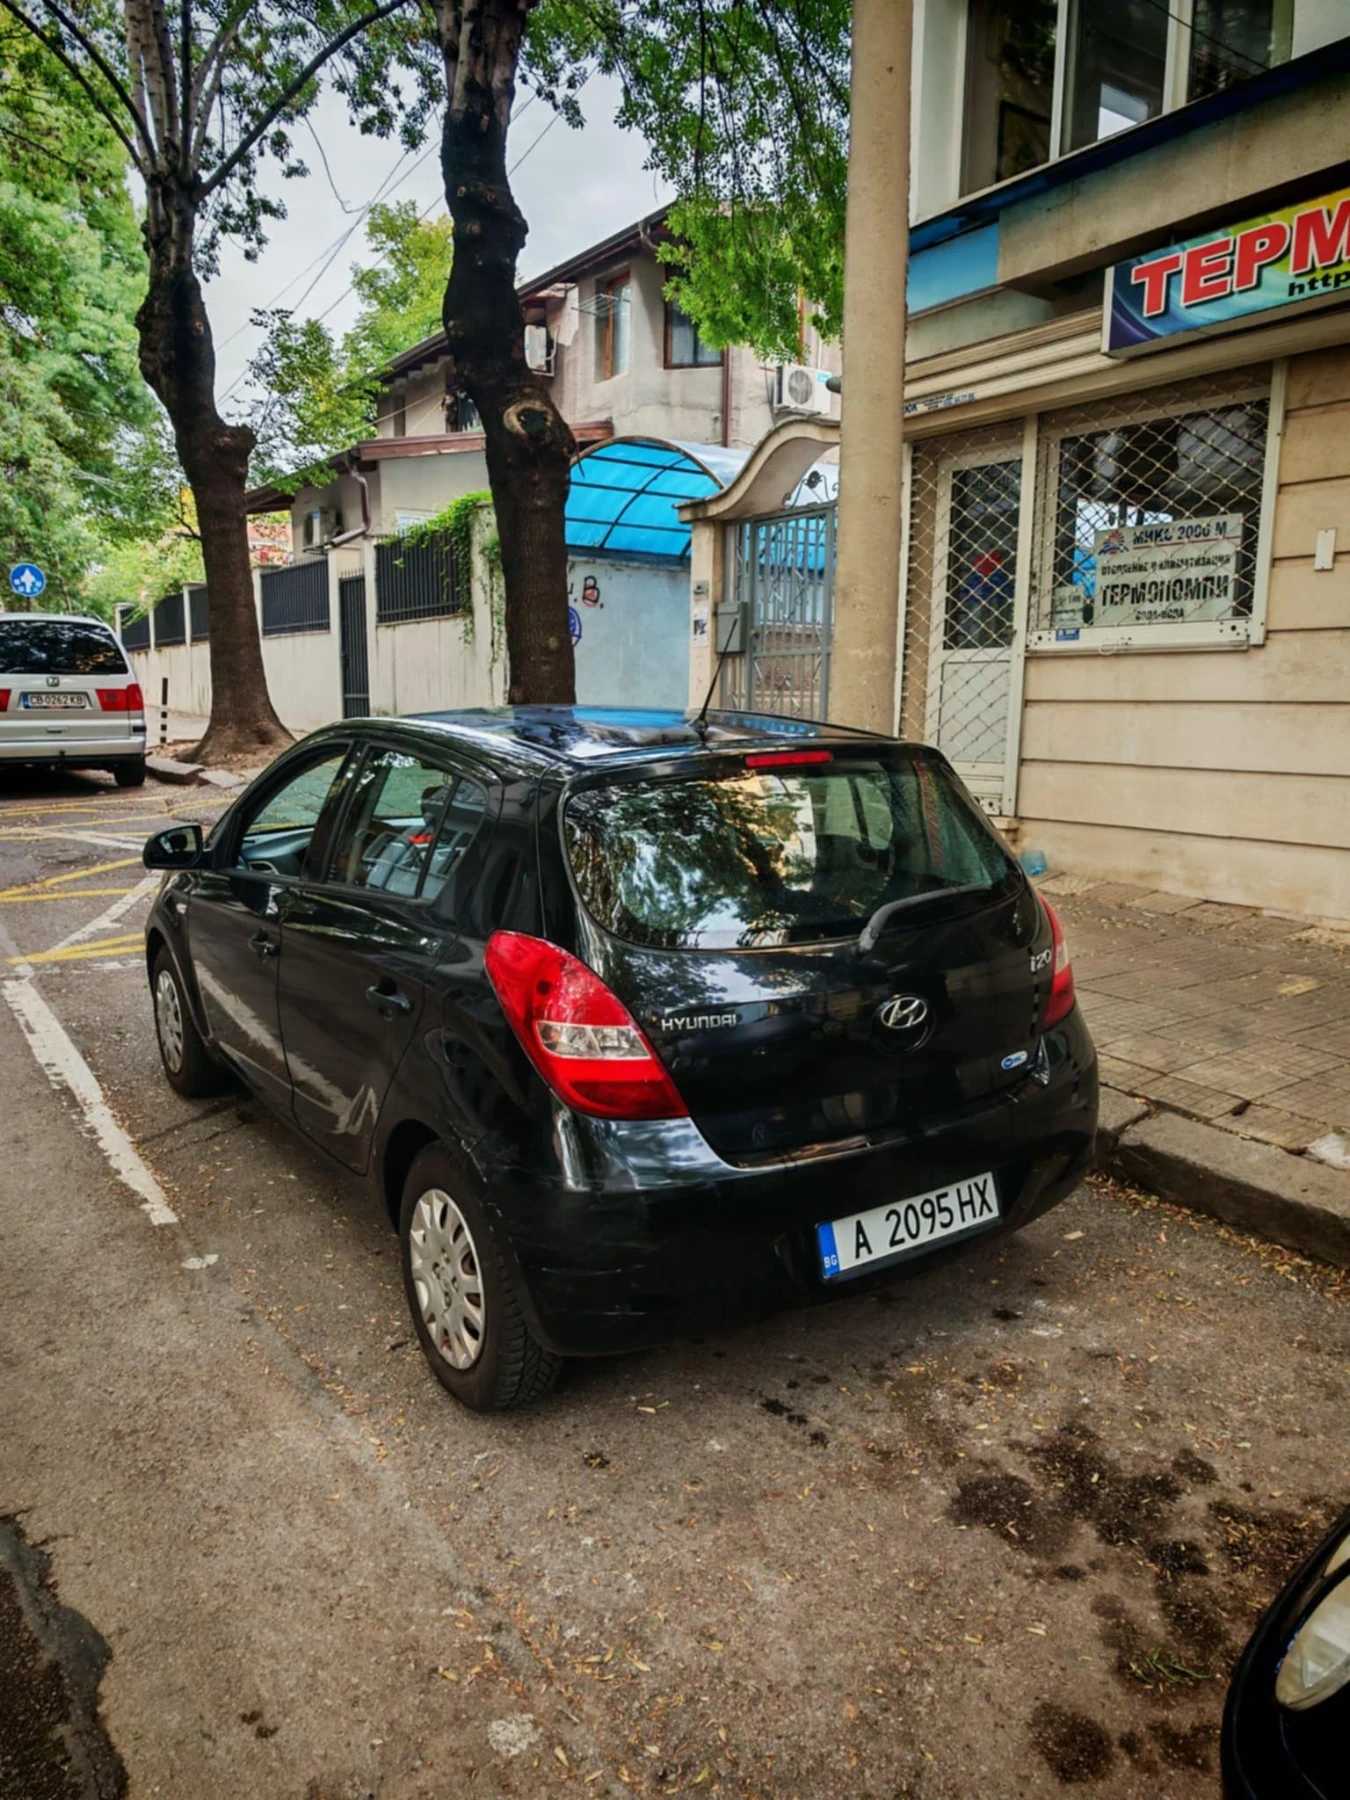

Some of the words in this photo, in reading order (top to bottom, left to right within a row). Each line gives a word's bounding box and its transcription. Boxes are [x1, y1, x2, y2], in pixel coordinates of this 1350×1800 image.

[1131, 198, 1350, 317] ТЕРМ
[1101, 575, 1229, 606] ТЕРМОПОМПИ
[661, 1014, 737, 1031] HYUNDAI
[885, 1192, 954, 1248] 2095
[824, 1255, 838, 1268] BG
